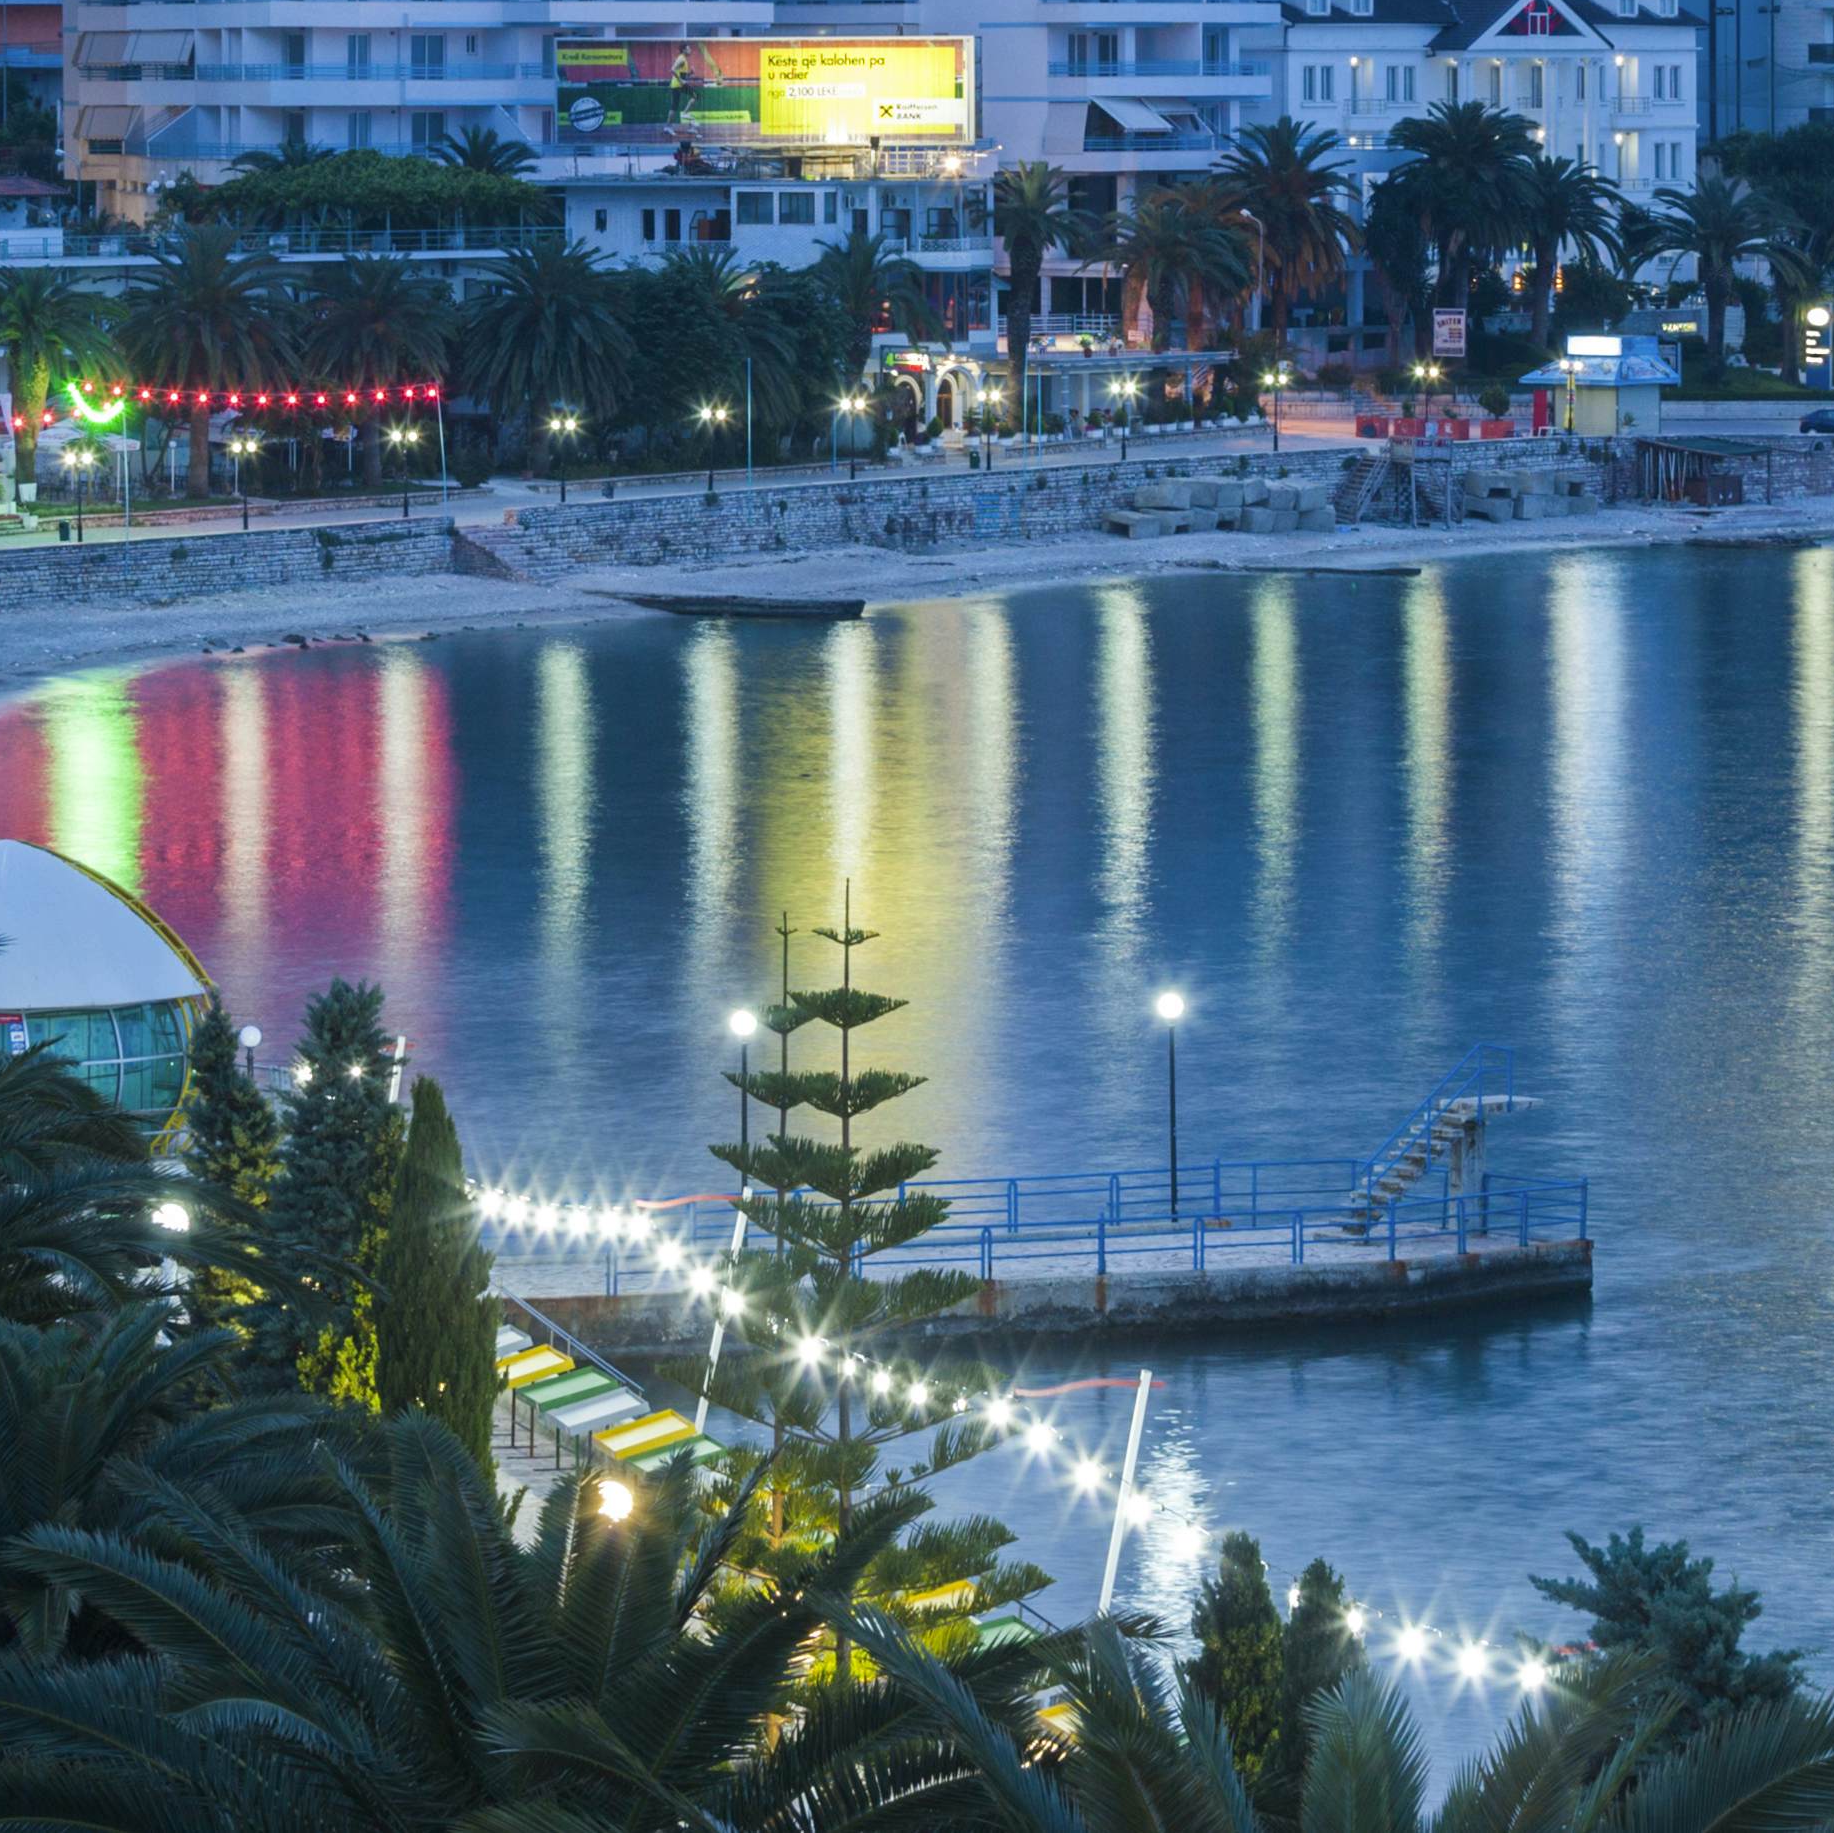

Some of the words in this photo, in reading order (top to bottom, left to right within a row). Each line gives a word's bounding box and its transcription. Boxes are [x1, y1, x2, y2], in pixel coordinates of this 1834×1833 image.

[767, 55, 798, 67] Këste
[801, 55, 816, 69] që
[820, 53, 865, 66] kalohen
[869, 57, 885, 68] pa
[767, 72, 775, 80] u
[779, 69, 808, 80] ndier
[788, 86, 815, 98] 2,100
